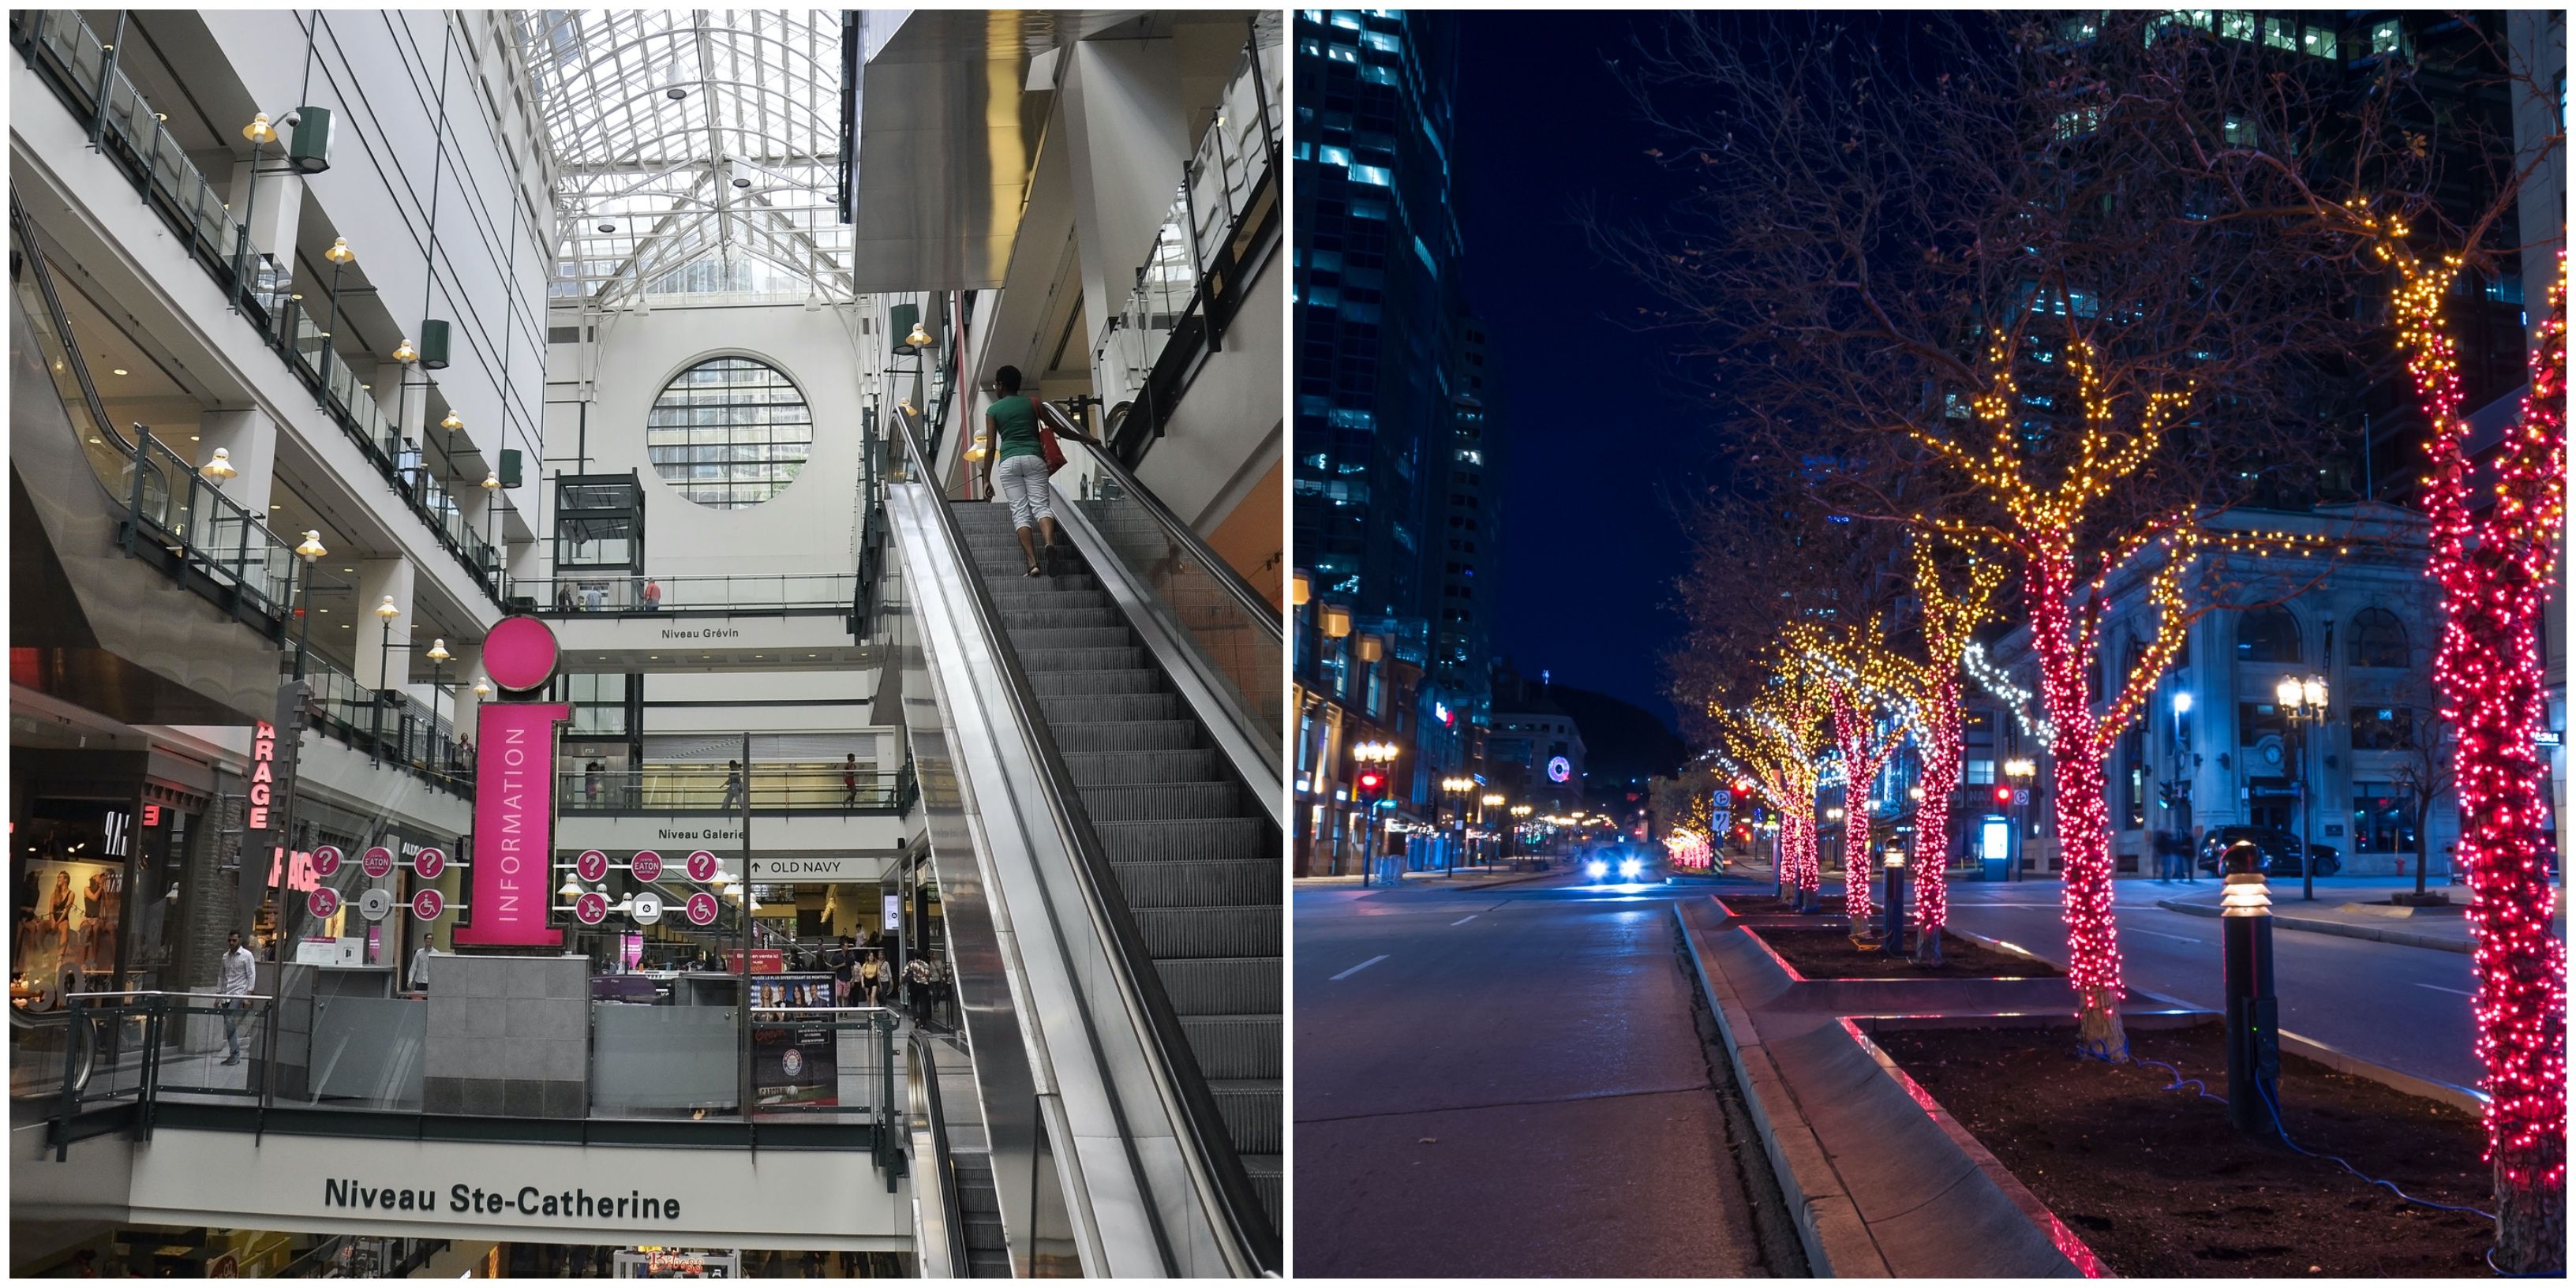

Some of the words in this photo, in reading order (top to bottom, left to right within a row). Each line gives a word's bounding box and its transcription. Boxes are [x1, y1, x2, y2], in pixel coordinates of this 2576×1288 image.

[661, 629, 699, 638] Niveau
[703, 627, 739, 638] Grévin
[498, 728, 525, 922] INFORMATION
[658, 829, 698, 840] Niveau
[702, 829, 743, 840] Galerie
[365, 858, 388, 867] EATON
[635, 862, 659, 871] EATON
[770, 862, 799, 873] OLD
[803, 861, 841, 873] NAVY
[324, 1178, 436, 1212] Niveau
[449, 1182, 681, 1220] Ste-Catherine
